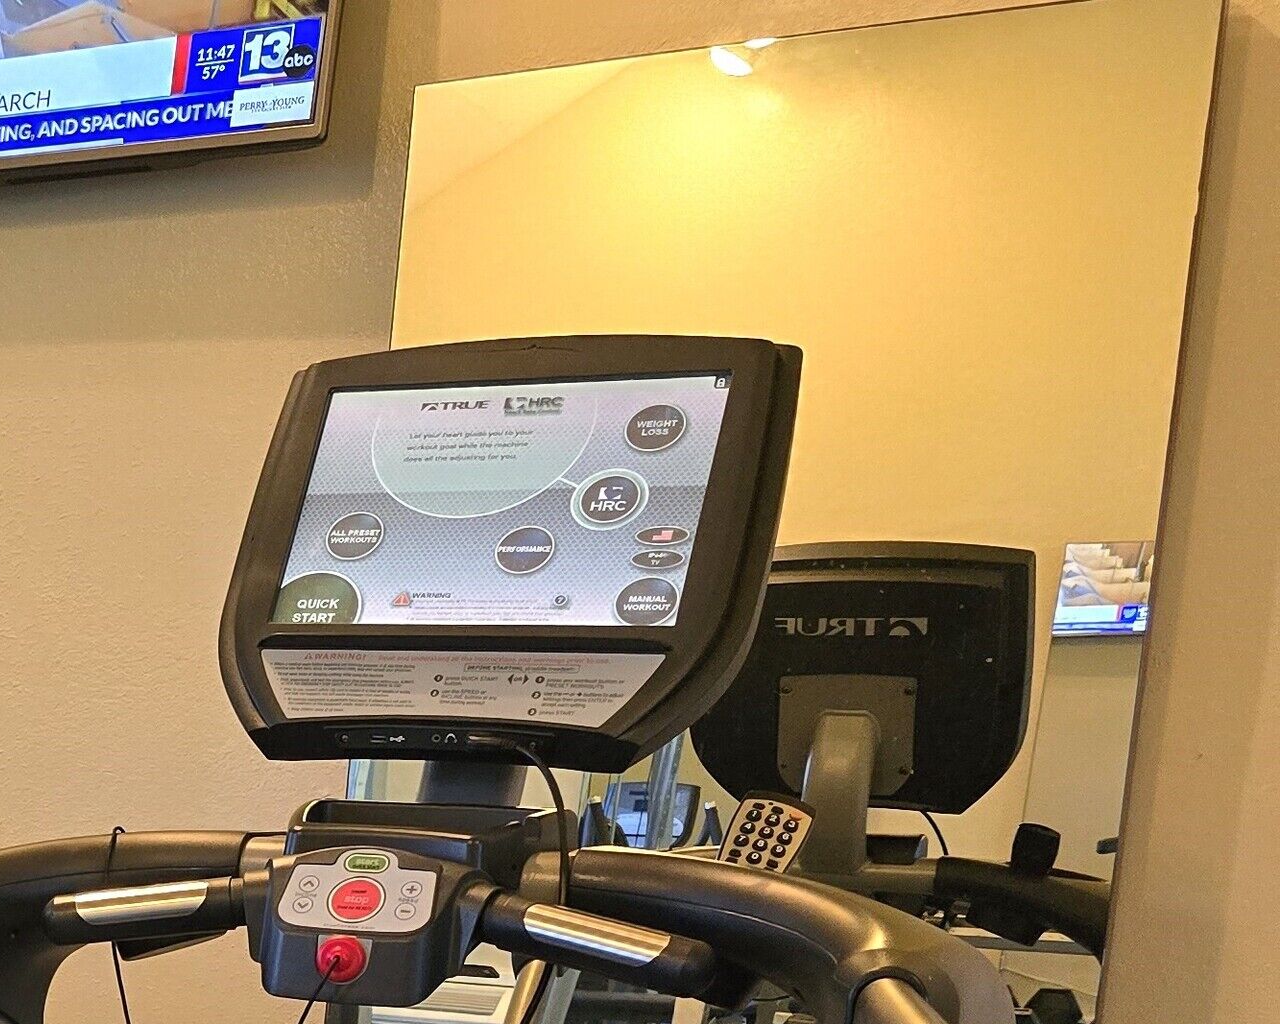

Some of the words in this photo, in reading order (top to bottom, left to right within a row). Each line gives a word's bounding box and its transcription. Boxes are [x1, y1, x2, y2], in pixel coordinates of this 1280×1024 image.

[197, 44, 236, 62] 11:47
[245, 31, 290, 70] 13
[284, 52, 314, 68] abc
[239, 100, 266, 111] PERRY
[272, 96, 305, 107] YOUNG
[37, 118, 78, 139] AND
[83, 109, 159, 134] SPACING
[161, 103, 204, 123] OUT
[440, 400, 490, 410] TRUE
[528, 396, 565, 408] HRC
[637, 419, 678, 428] WEIGHT
[641, 428, 669, 437] LOSS
[590, 500, 627, 512] HRC
[330, 529, 346, 537] ALL
[348, 529, 380, 537] PRESET
[330, 536, 378, 544] WORKOUTS
[497, 545, 552, 553] PERFORMANCE
[297, 598, 340, 609] QUICK
[623, 603, 672, 611] WORKOUT
[292, 612, 336, 624] START
[343, 895, 370, 904] stop
